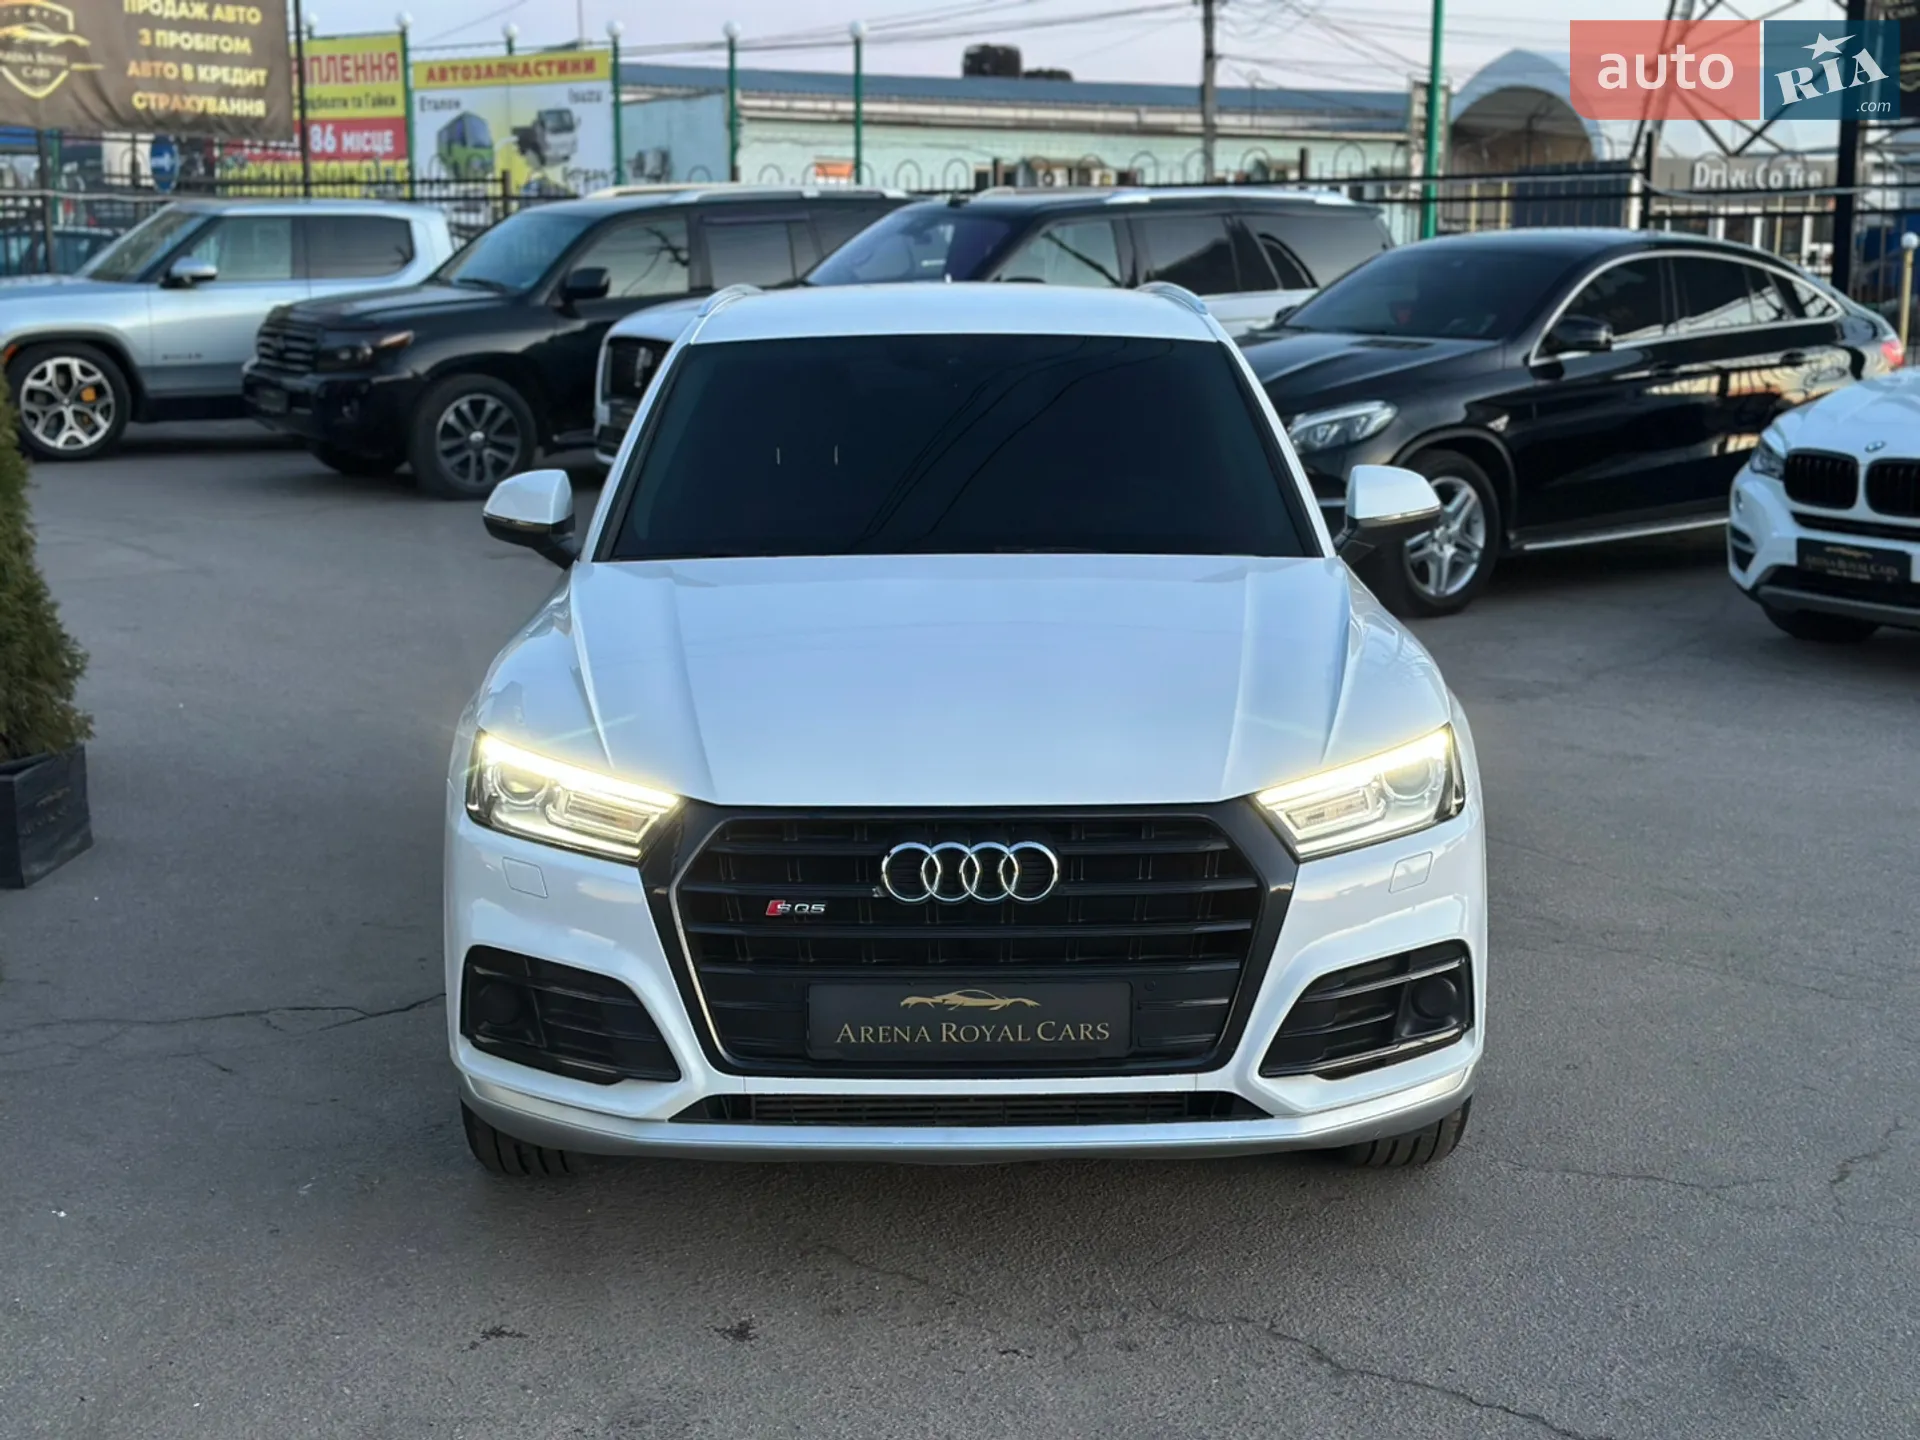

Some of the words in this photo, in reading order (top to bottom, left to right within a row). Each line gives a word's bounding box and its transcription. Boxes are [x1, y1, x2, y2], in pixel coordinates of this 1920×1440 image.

[123, 0, 209, 20] ПРОДАЖ
[211, 3, 262, 25] АВТО
[138, 28, 151, 46] З
[127, 60, 179, 80] АВТО
[181, 62, 195, 82] В
[197, 64, 268, 87] КРЕДИТ
[427, 57, 596, 84] АВТОЗАПЧАСТИНИ
[131, 91, 266, 118] СТРАХУВАННЯ
[310, 123, 336, 153] 86
[768, 901, 826, 915] SQ5
[834, 1022, 931, 1044] ARENA
[941, 1022, 1031, 1043] ROYAL
[1037, 1020, 1110, 1042] CARS
